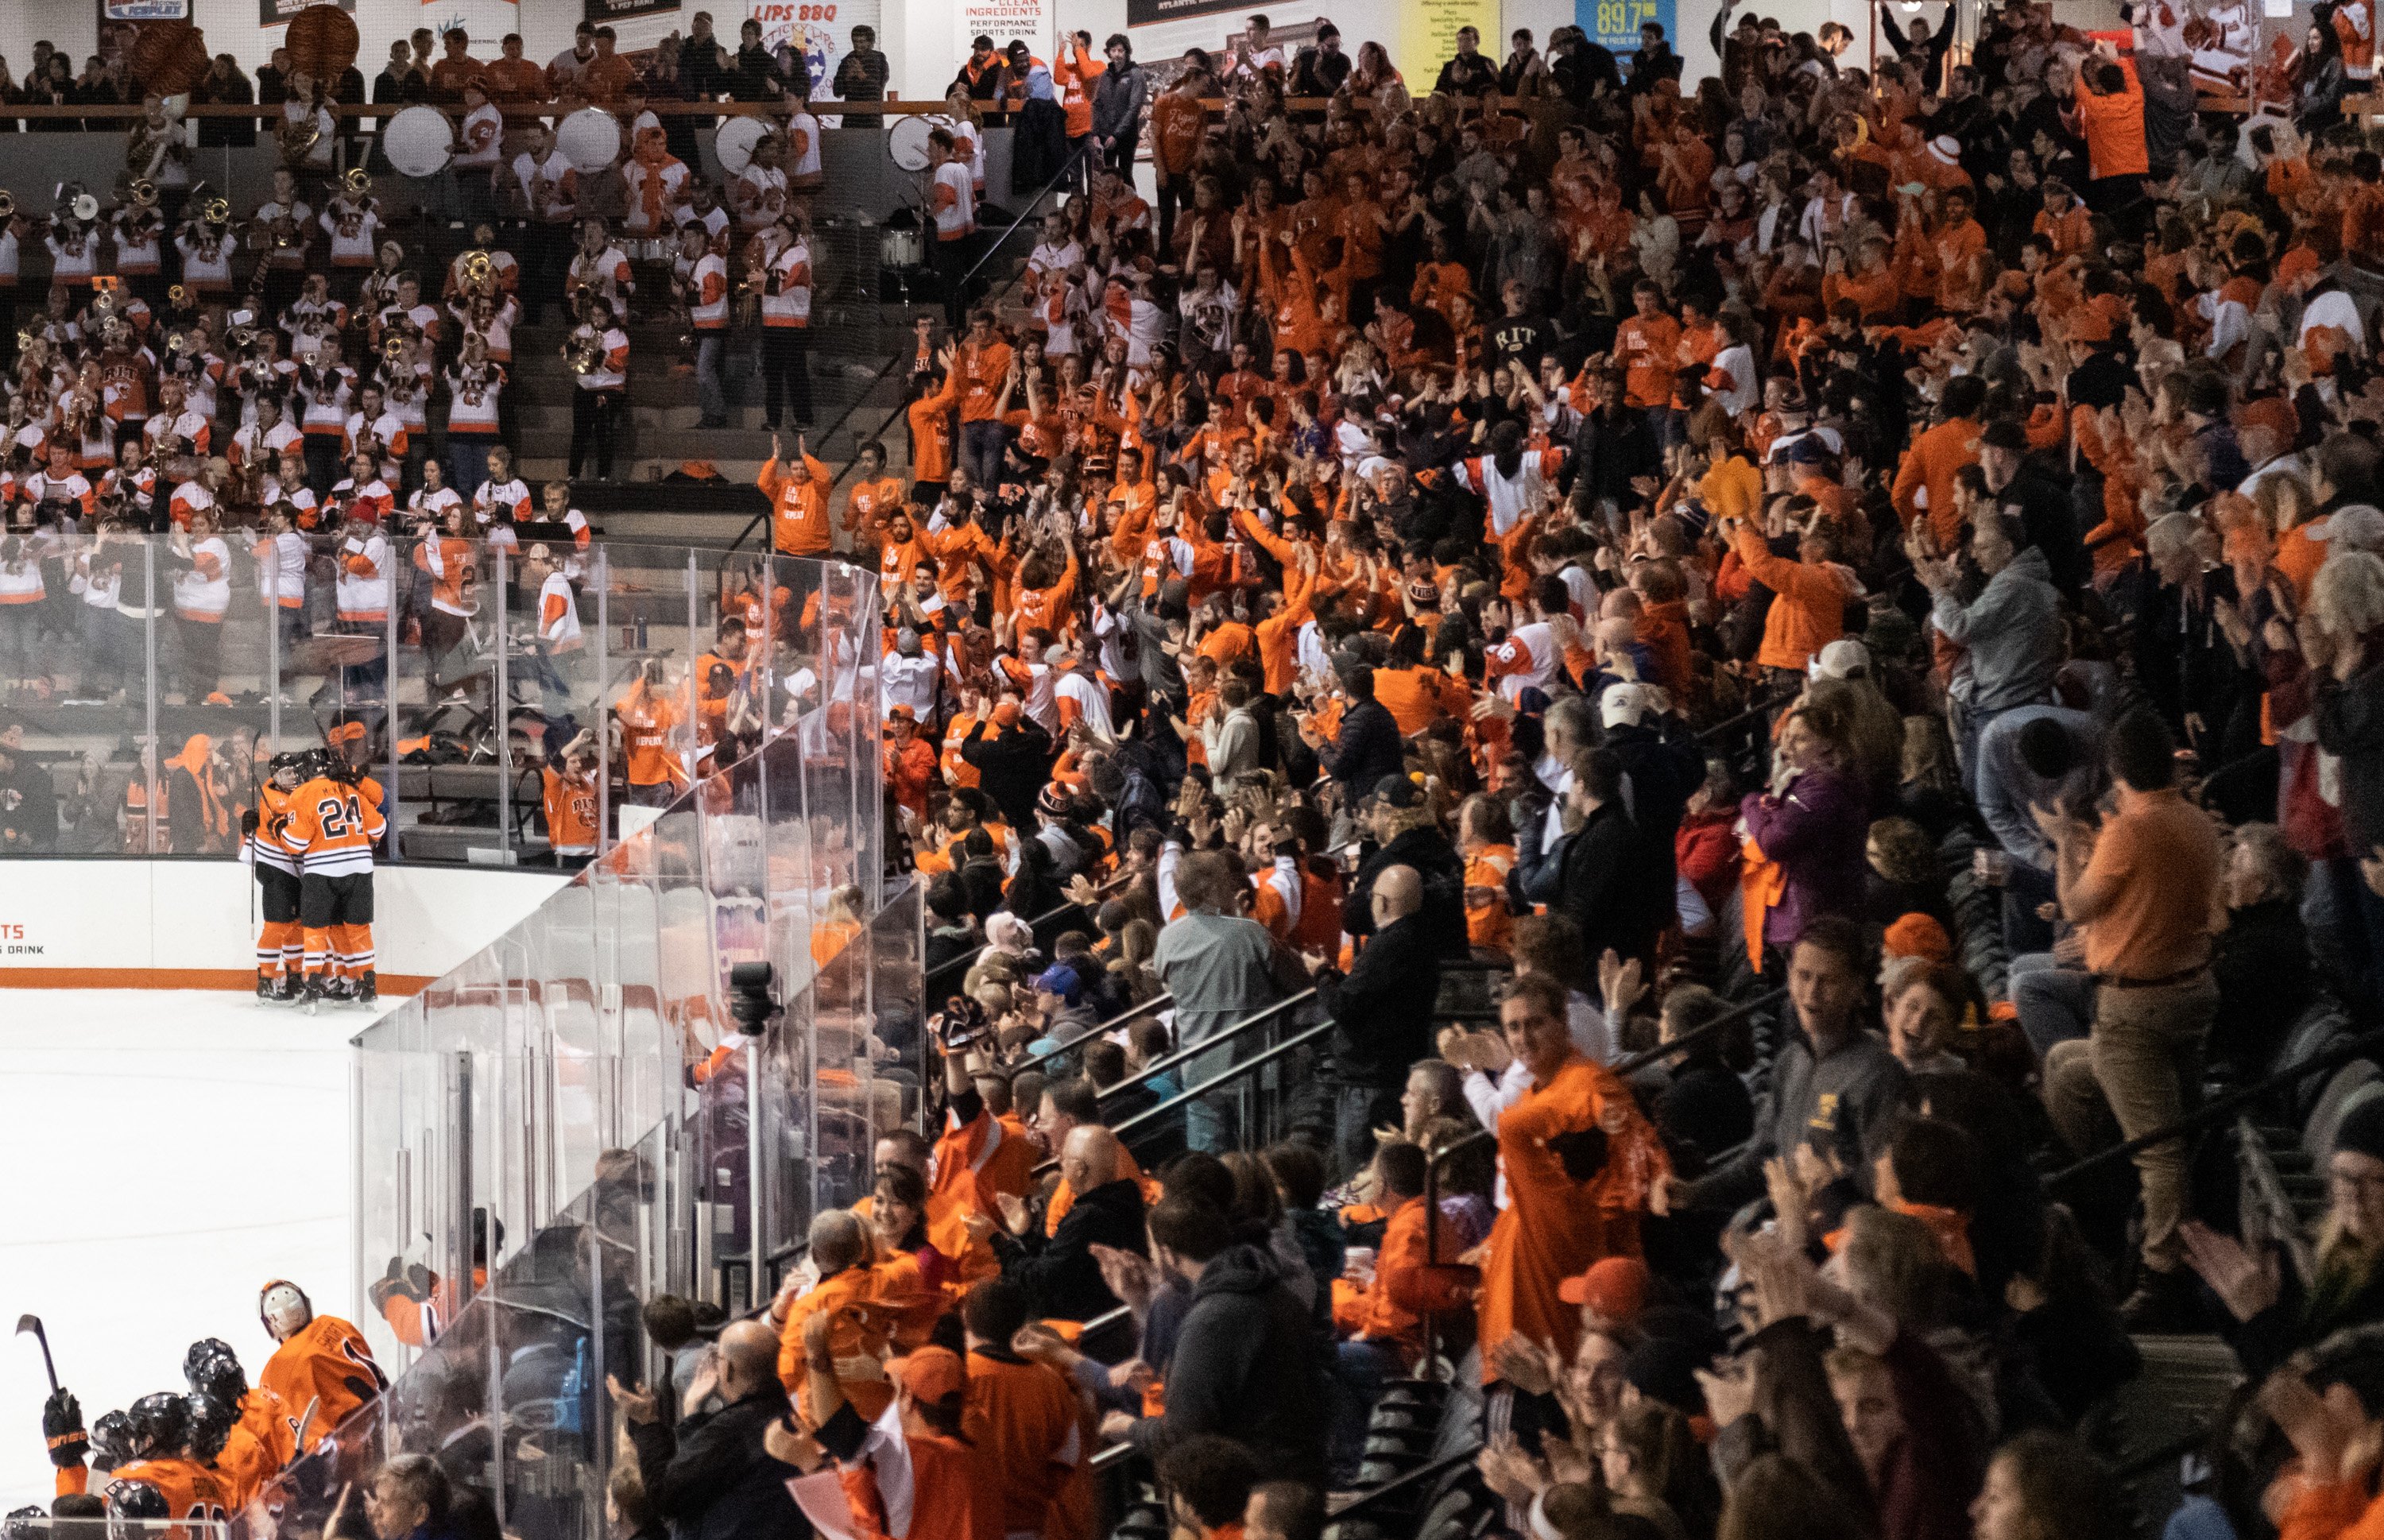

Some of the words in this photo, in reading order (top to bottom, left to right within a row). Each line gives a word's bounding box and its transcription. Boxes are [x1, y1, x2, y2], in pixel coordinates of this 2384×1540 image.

[754, 4, 794, 22] LIPS
[799, 4, 838, 22] BBQ
[966, 7, 1042, 16] INGREDIENTS
[1597, 2, 1642, 34] 89.7
[1496, 327, 1536, 350] RIT
[317, 794, 364, 841] 24
[8, 946, 44, 954] DRINK
